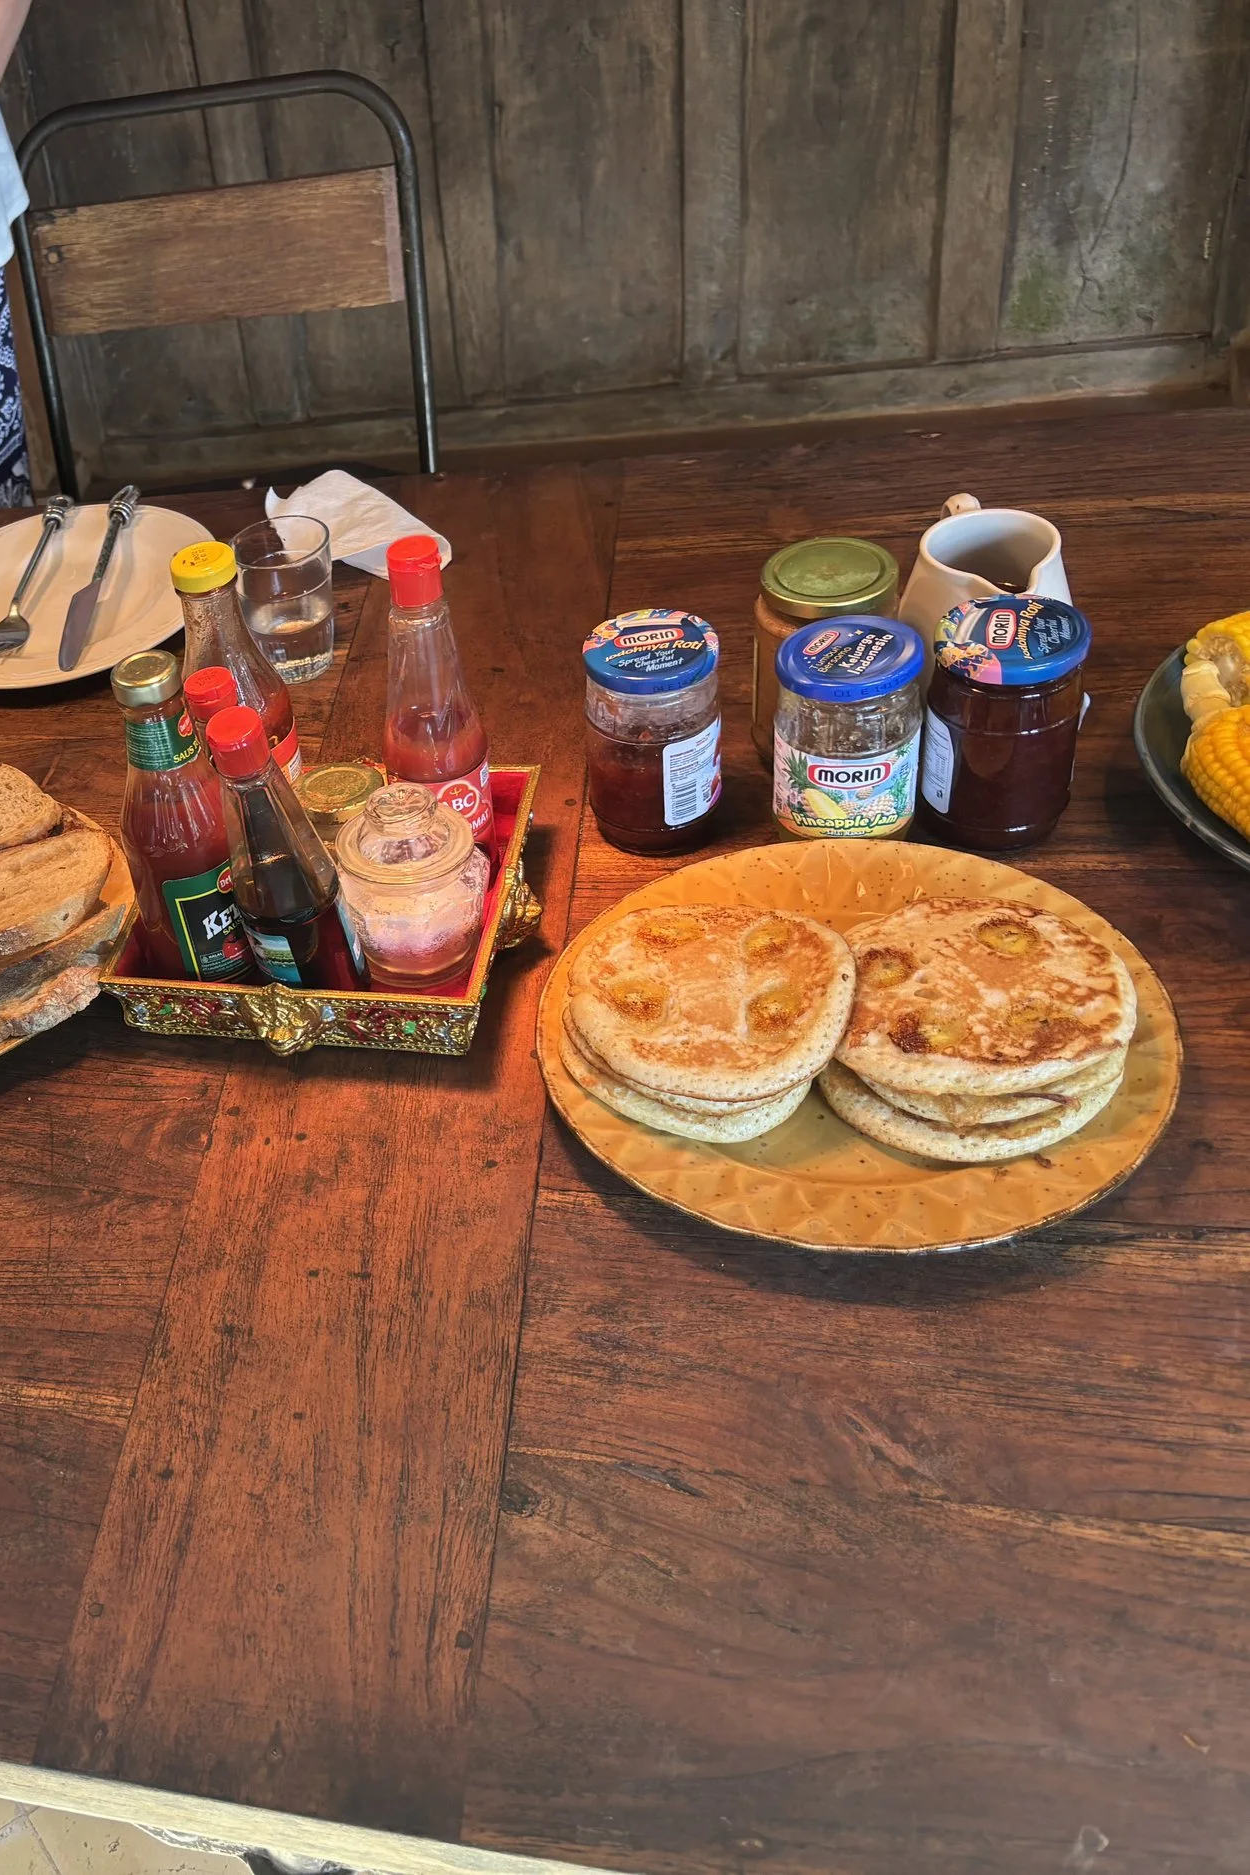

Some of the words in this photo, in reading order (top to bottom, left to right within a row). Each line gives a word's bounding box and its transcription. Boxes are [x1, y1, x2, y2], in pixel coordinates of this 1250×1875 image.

[1019, 599, 1045, 620] Roti
[622, 630, 675, 645] MORIN
[992, 614, 1011, 644] MORIN
[605, 642, 670, 662] Jodohnya
[672, 639, 705, 651] Roti
[808, 633, 833, 652] MORIN
[839, 634, 876, 668] Keluarga
[618, 653, 650, 667] Spread
[655, 648, 676, 657] Your
[635, 654, 675, 668] Cheerful
[847, 633, 894, 675] Indonesia
[173, 746, 195, 764] SAUS
[818, 768, 881, 783] MORIN
[443, 793, 474, 811] BC
[793, 812, 869, 829] Pineapple
[871, 813, 898, 827] Jam
